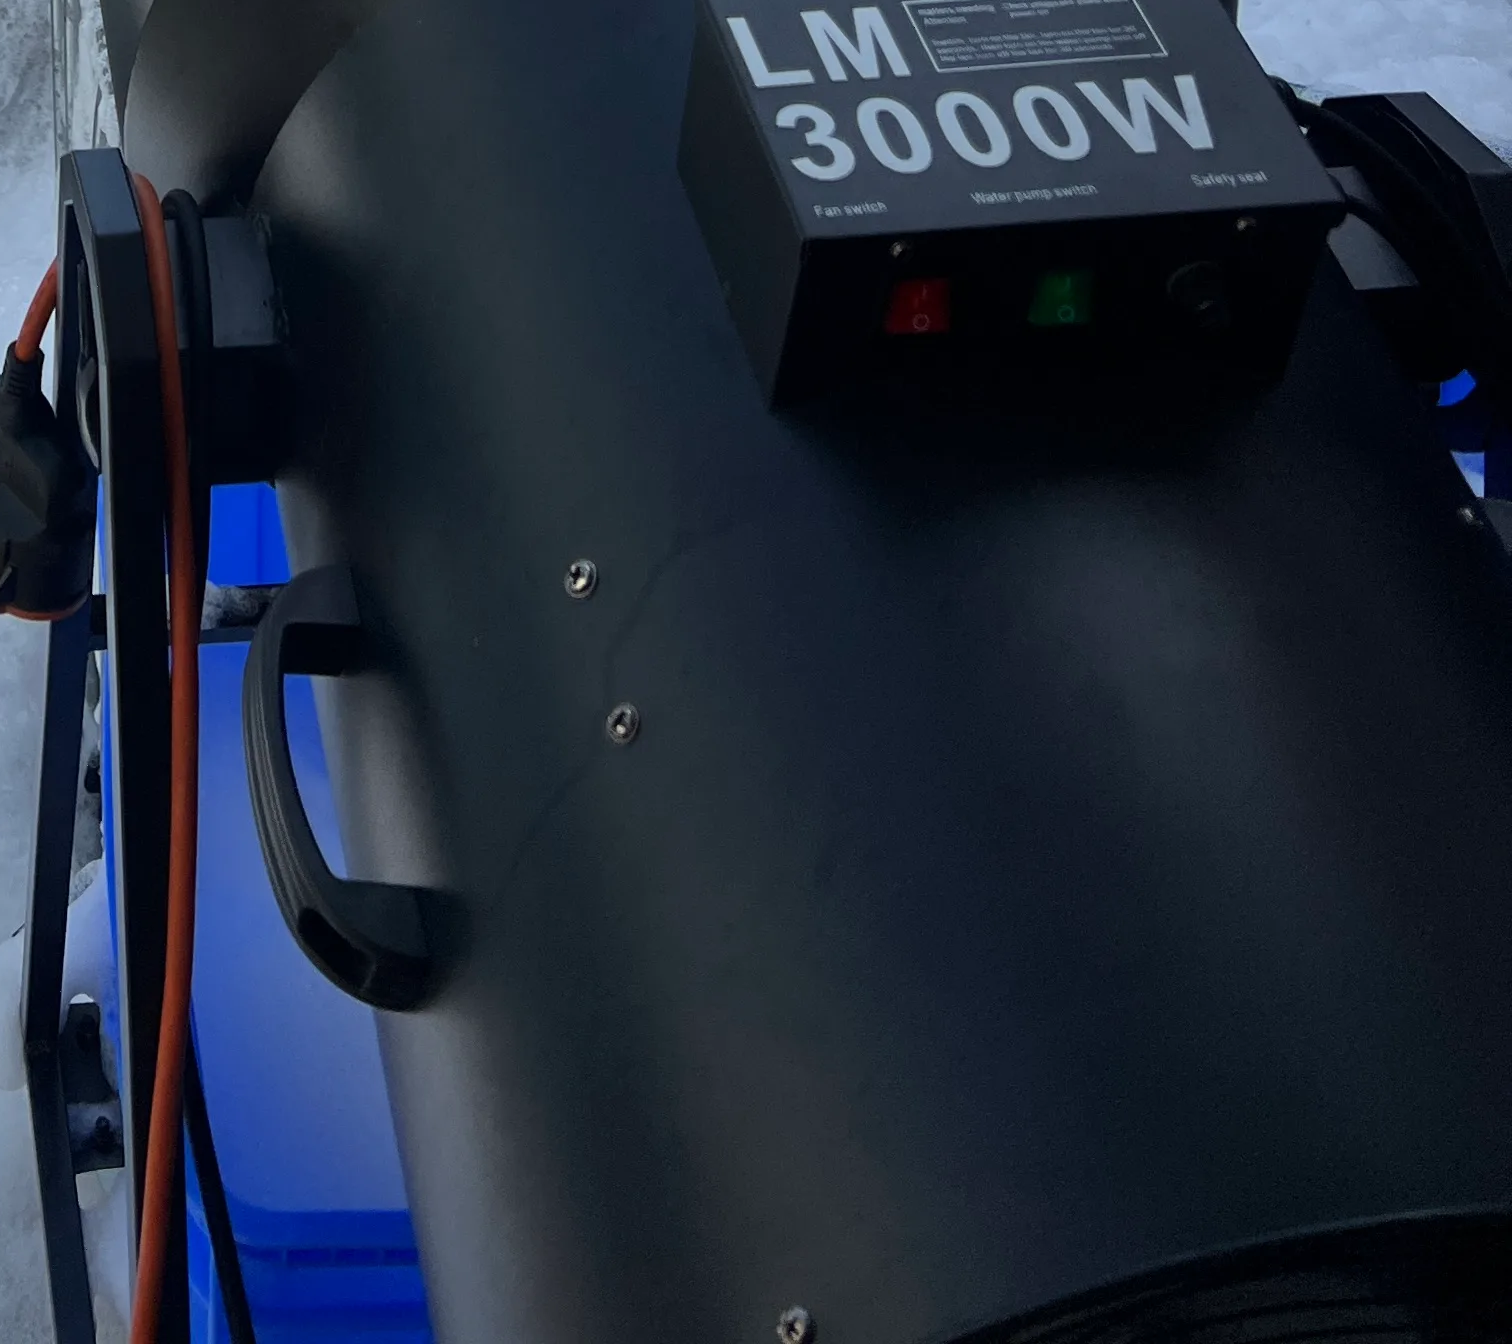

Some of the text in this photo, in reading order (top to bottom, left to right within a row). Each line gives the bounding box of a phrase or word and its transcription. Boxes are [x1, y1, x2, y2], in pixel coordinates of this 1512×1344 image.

[727, 7, 912, 88] LM
[775, 74, 1214, 181] 3000W
[1190, 172, 1236, 188] Safety
[969, 183, 1099, 205] Water pump switch
[813, 201, 888, 218] Fan switch
